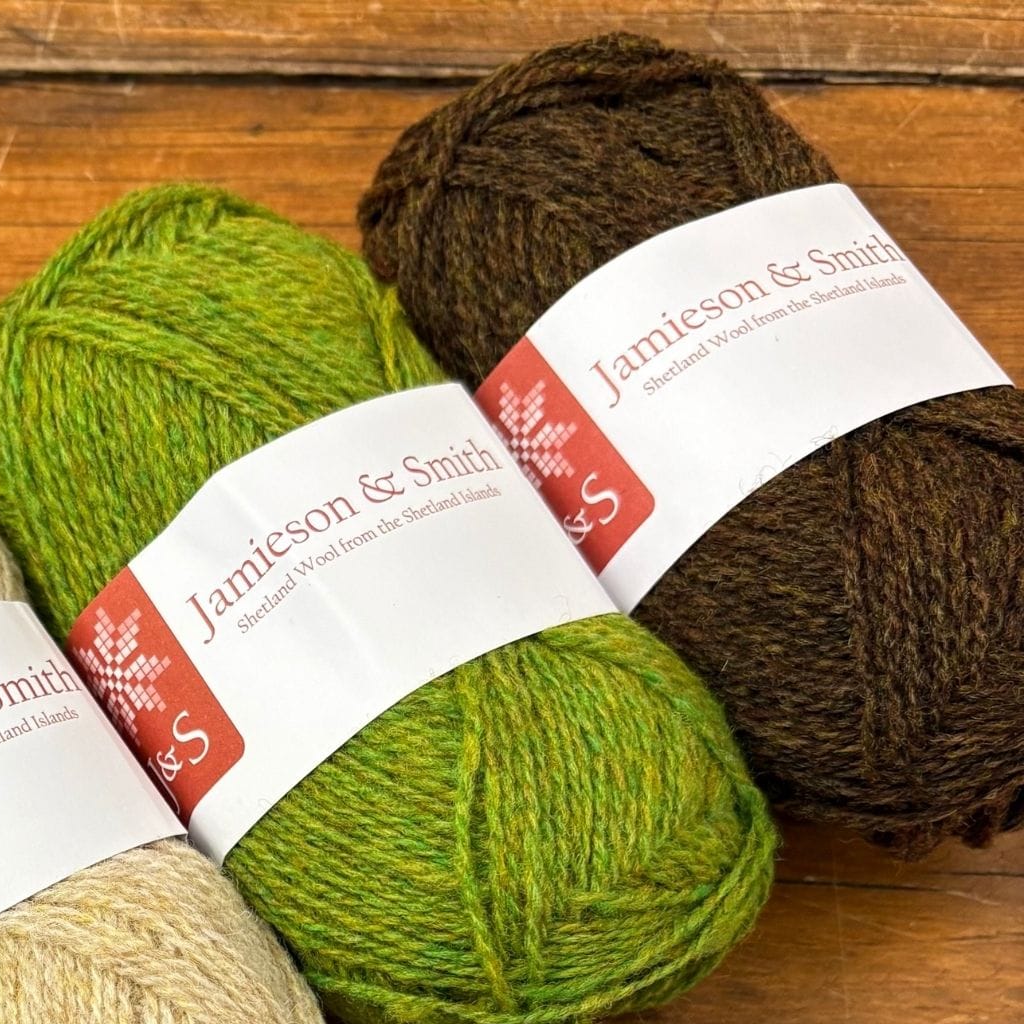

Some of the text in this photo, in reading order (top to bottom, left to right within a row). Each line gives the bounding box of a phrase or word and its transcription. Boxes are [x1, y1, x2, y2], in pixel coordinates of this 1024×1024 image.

[589, 234, 906, 408] Jamieson & Smith
[642, 272, 907, 395] Shetland Wool from the Shetland Islands
[185, 438, 503, 645] Jamieson & Smith
[237, 483, 502, 634] Shetland Wool from the Shetland Islands
[563, 471, 619, 545] &S
[31, 706, 79, 729] Islands
